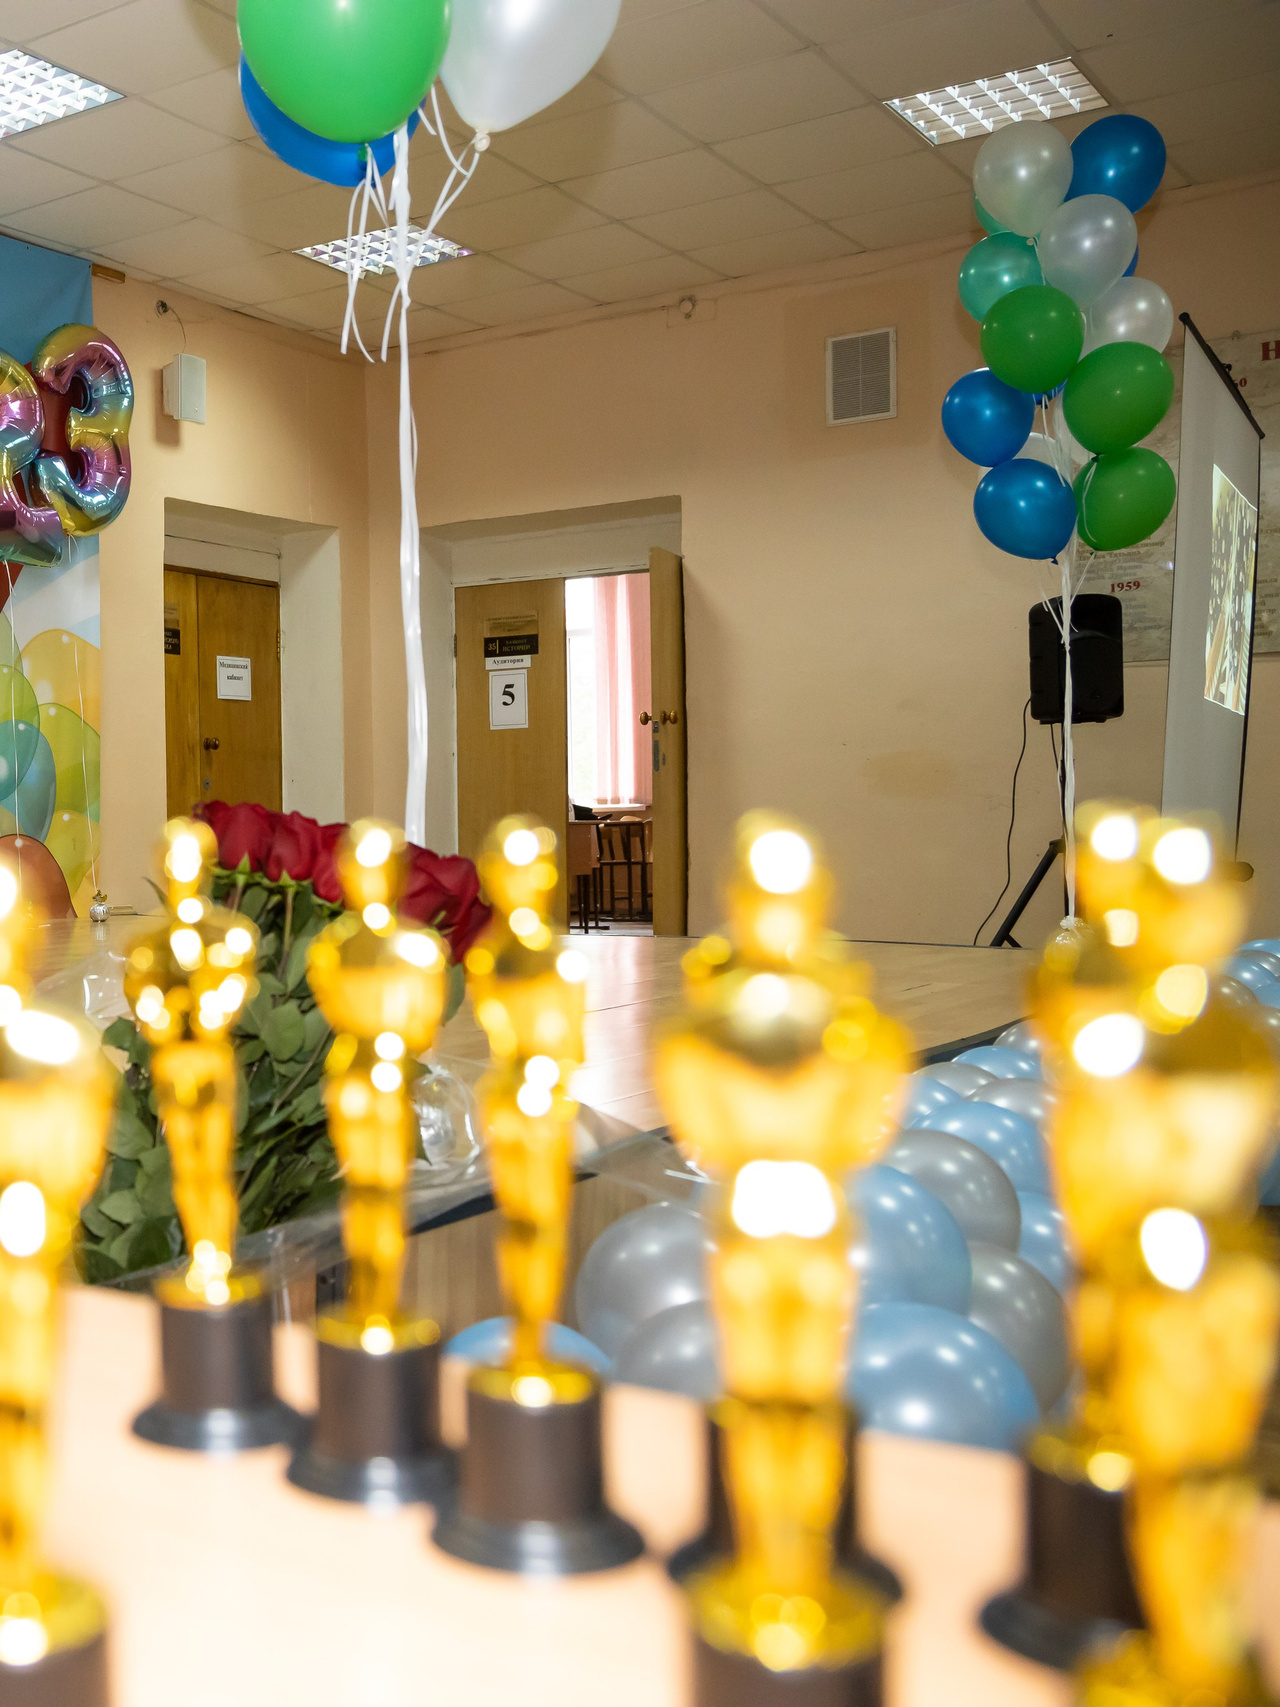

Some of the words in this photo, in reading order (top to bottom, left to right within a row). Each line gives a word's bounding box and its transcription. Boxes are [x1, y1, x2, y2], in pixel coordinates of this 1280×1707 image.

[1110, 580, 1141, 593] 1959
[488, 643, 497, 651] 35
[492, 657, 524, 666] Аудитория
[502, 684, 515, 706] 5
